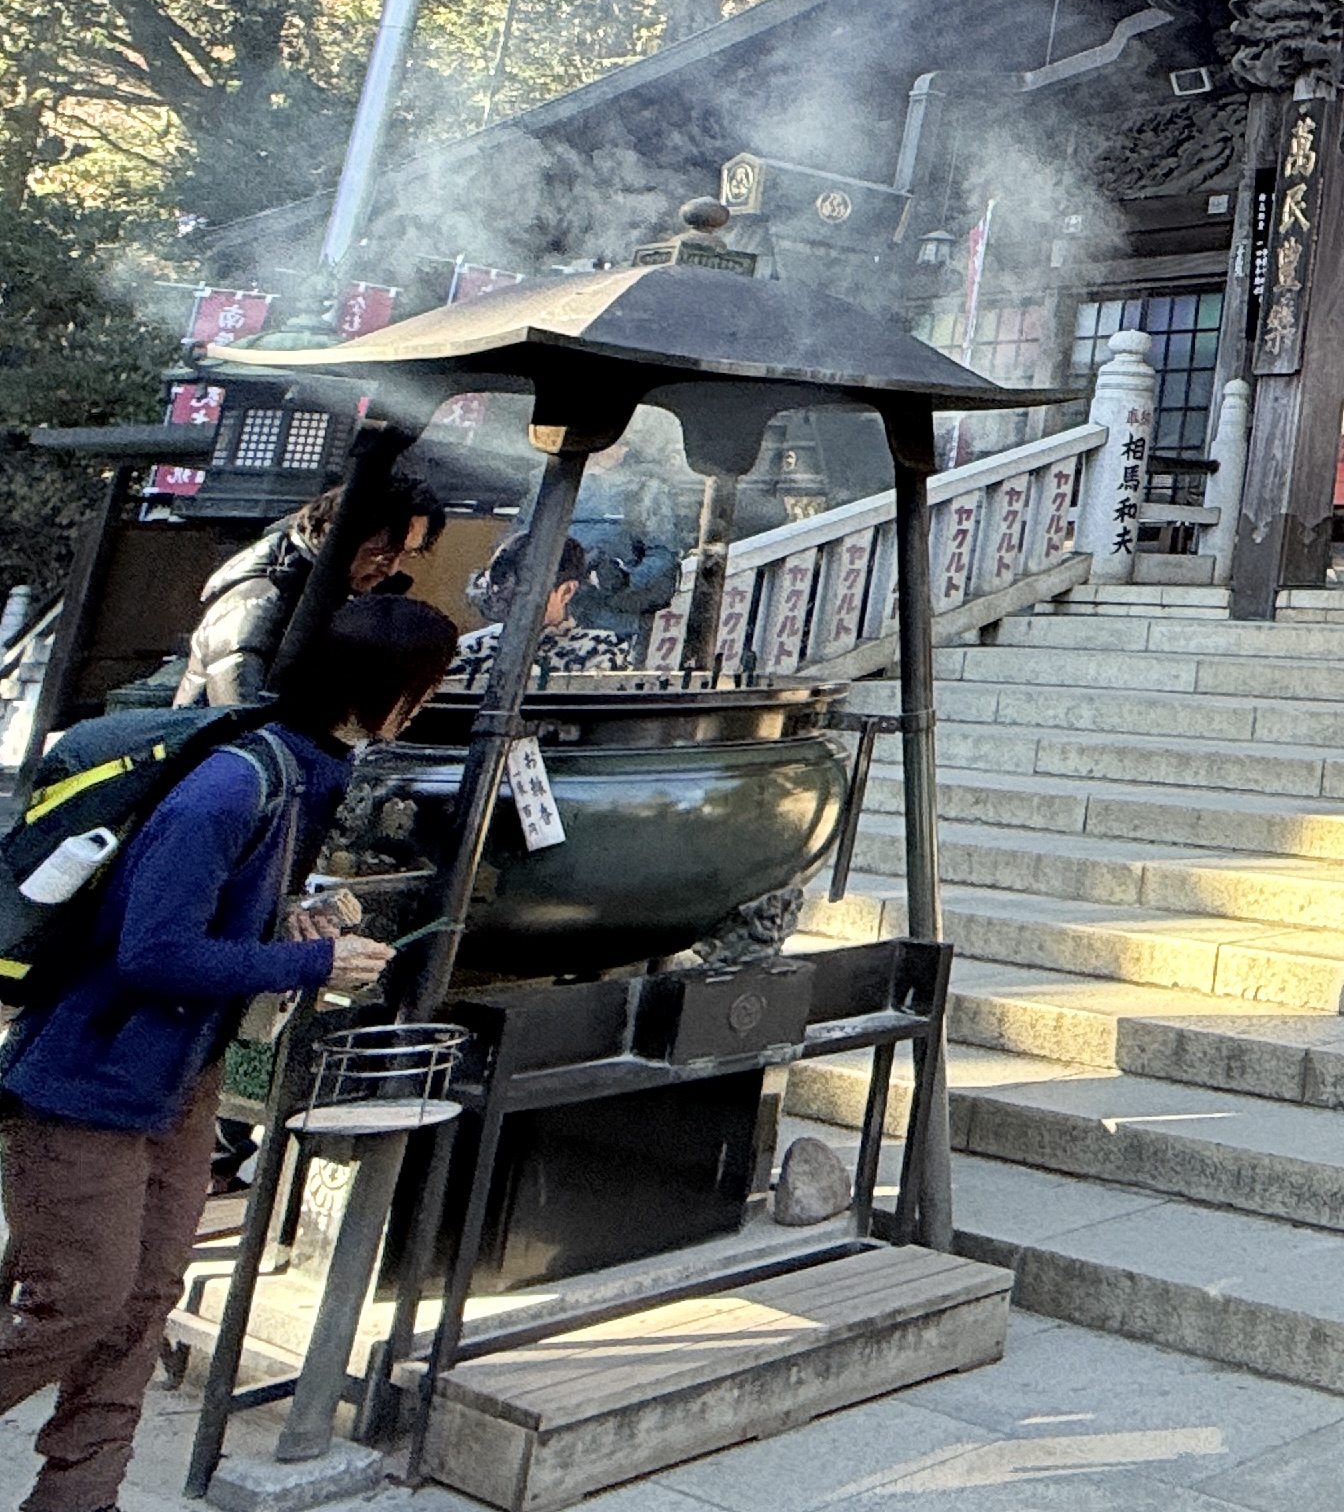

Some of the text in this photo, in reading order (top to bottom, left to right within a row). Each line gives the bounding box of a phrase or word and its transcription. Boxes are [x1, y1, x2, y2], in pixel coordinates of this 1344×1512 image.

[994, 486, 1024, 578] ヤクルト
[1044, 470, 1071, 558] ヤクルト
[1112, 432, 1147, 556] 相馬和夫
[834, 544, 870, 641] ヤクルト
[943, 505, 974, 598] ヤクルト
[774, 565, 810, 666] ヤクルト
